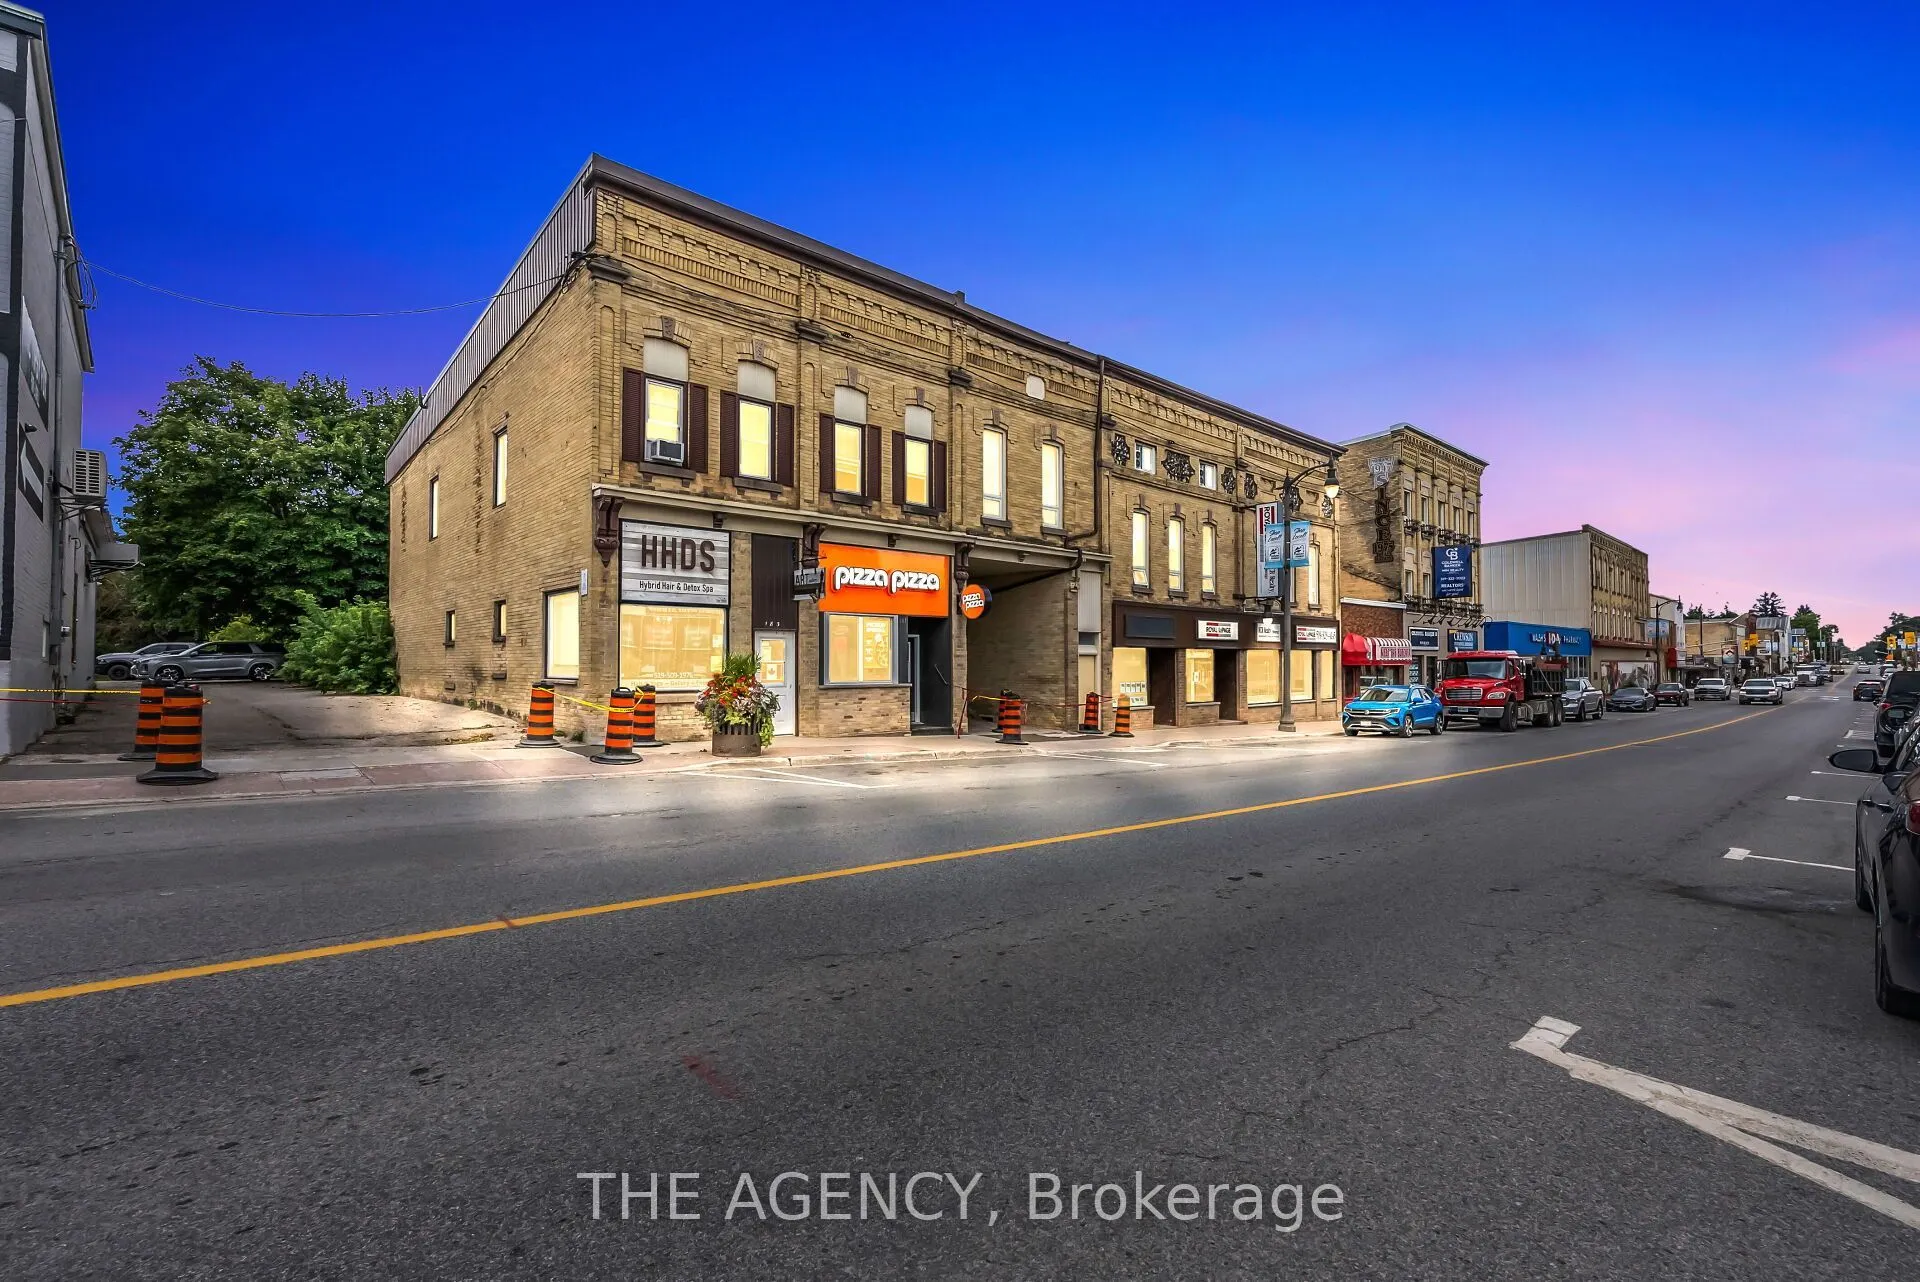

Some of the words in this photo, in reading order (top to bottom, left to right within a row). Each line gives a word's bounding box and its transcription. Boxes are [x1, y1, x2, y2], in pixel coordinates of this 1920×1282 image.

[641, 534, 716, 572] HHDS
[639, 580, 660, 591] Hybrid
[662, 581, 674, 590] Hair
[676, 583, 681, 591] &
[683, 583, 700, 592] Detox
[702, 584, 714, 593] Spa
[834, 566, 888, 591] pizza
[890, 569, 941, 595] pizza
